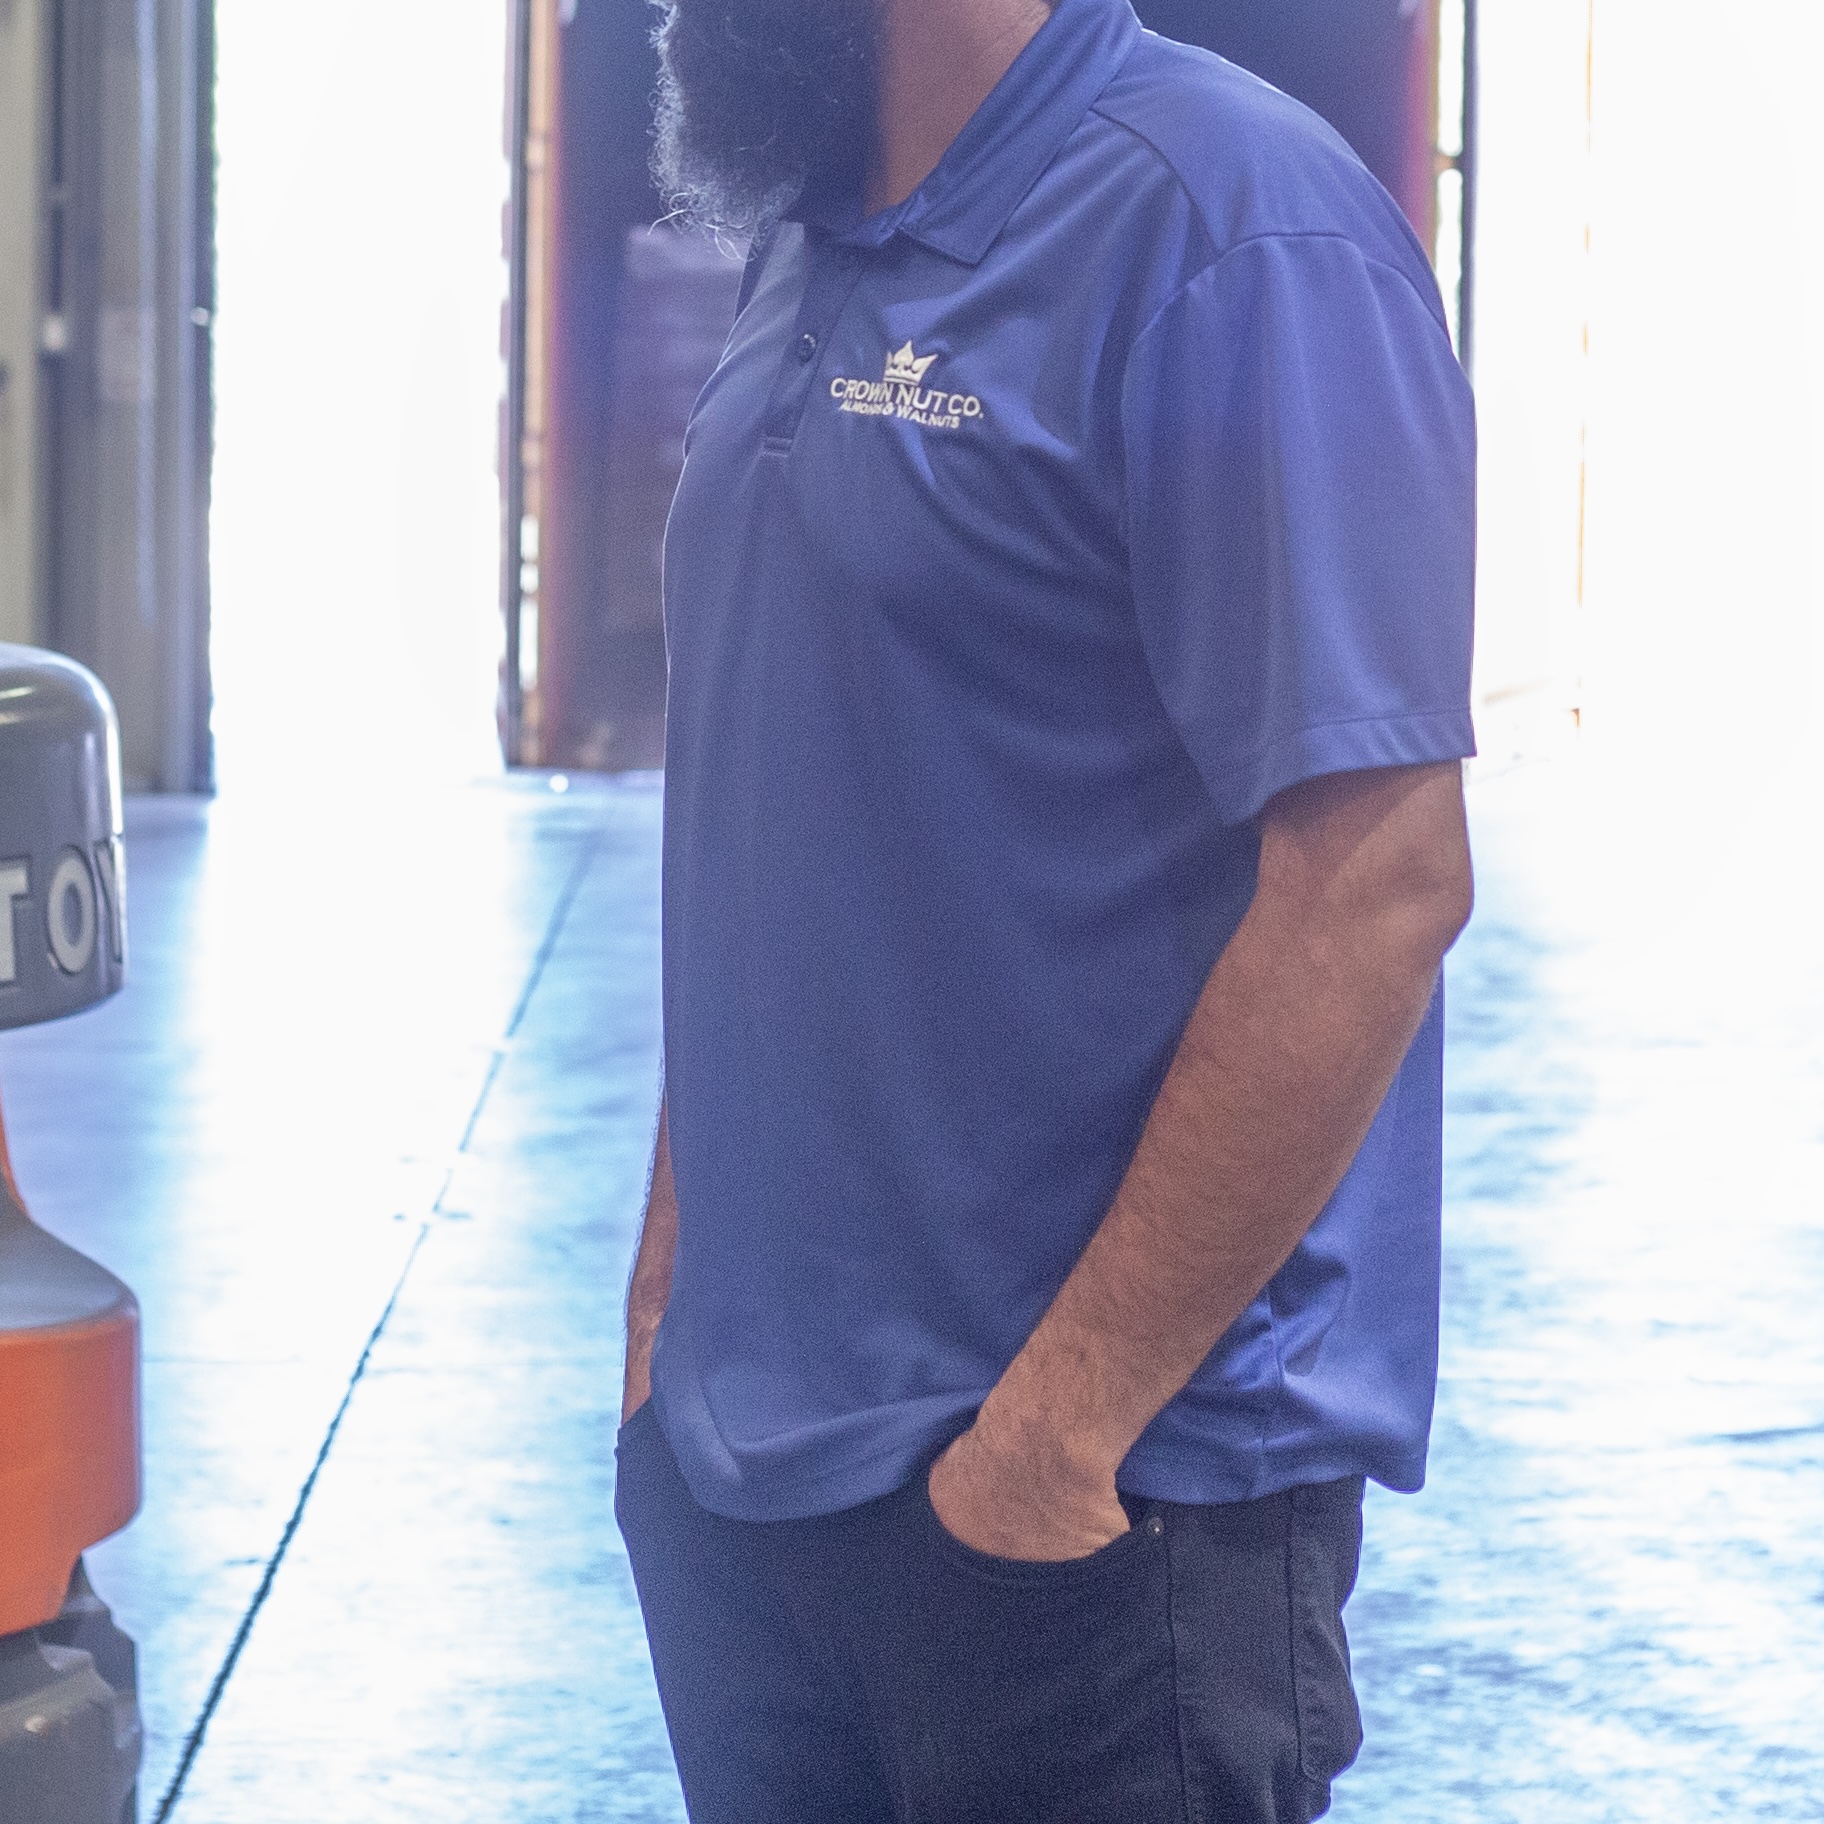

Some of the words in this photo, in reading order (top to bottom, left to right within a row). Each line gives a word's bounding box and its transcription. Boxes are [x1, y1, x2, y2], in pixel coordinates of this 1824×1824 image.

[830, 377, 893, 403] CROWN
[895, 384, 948, 413] NUT
[947, 393, 984, 419] CO.
[896, 404, 961, 429] WALNUTS
